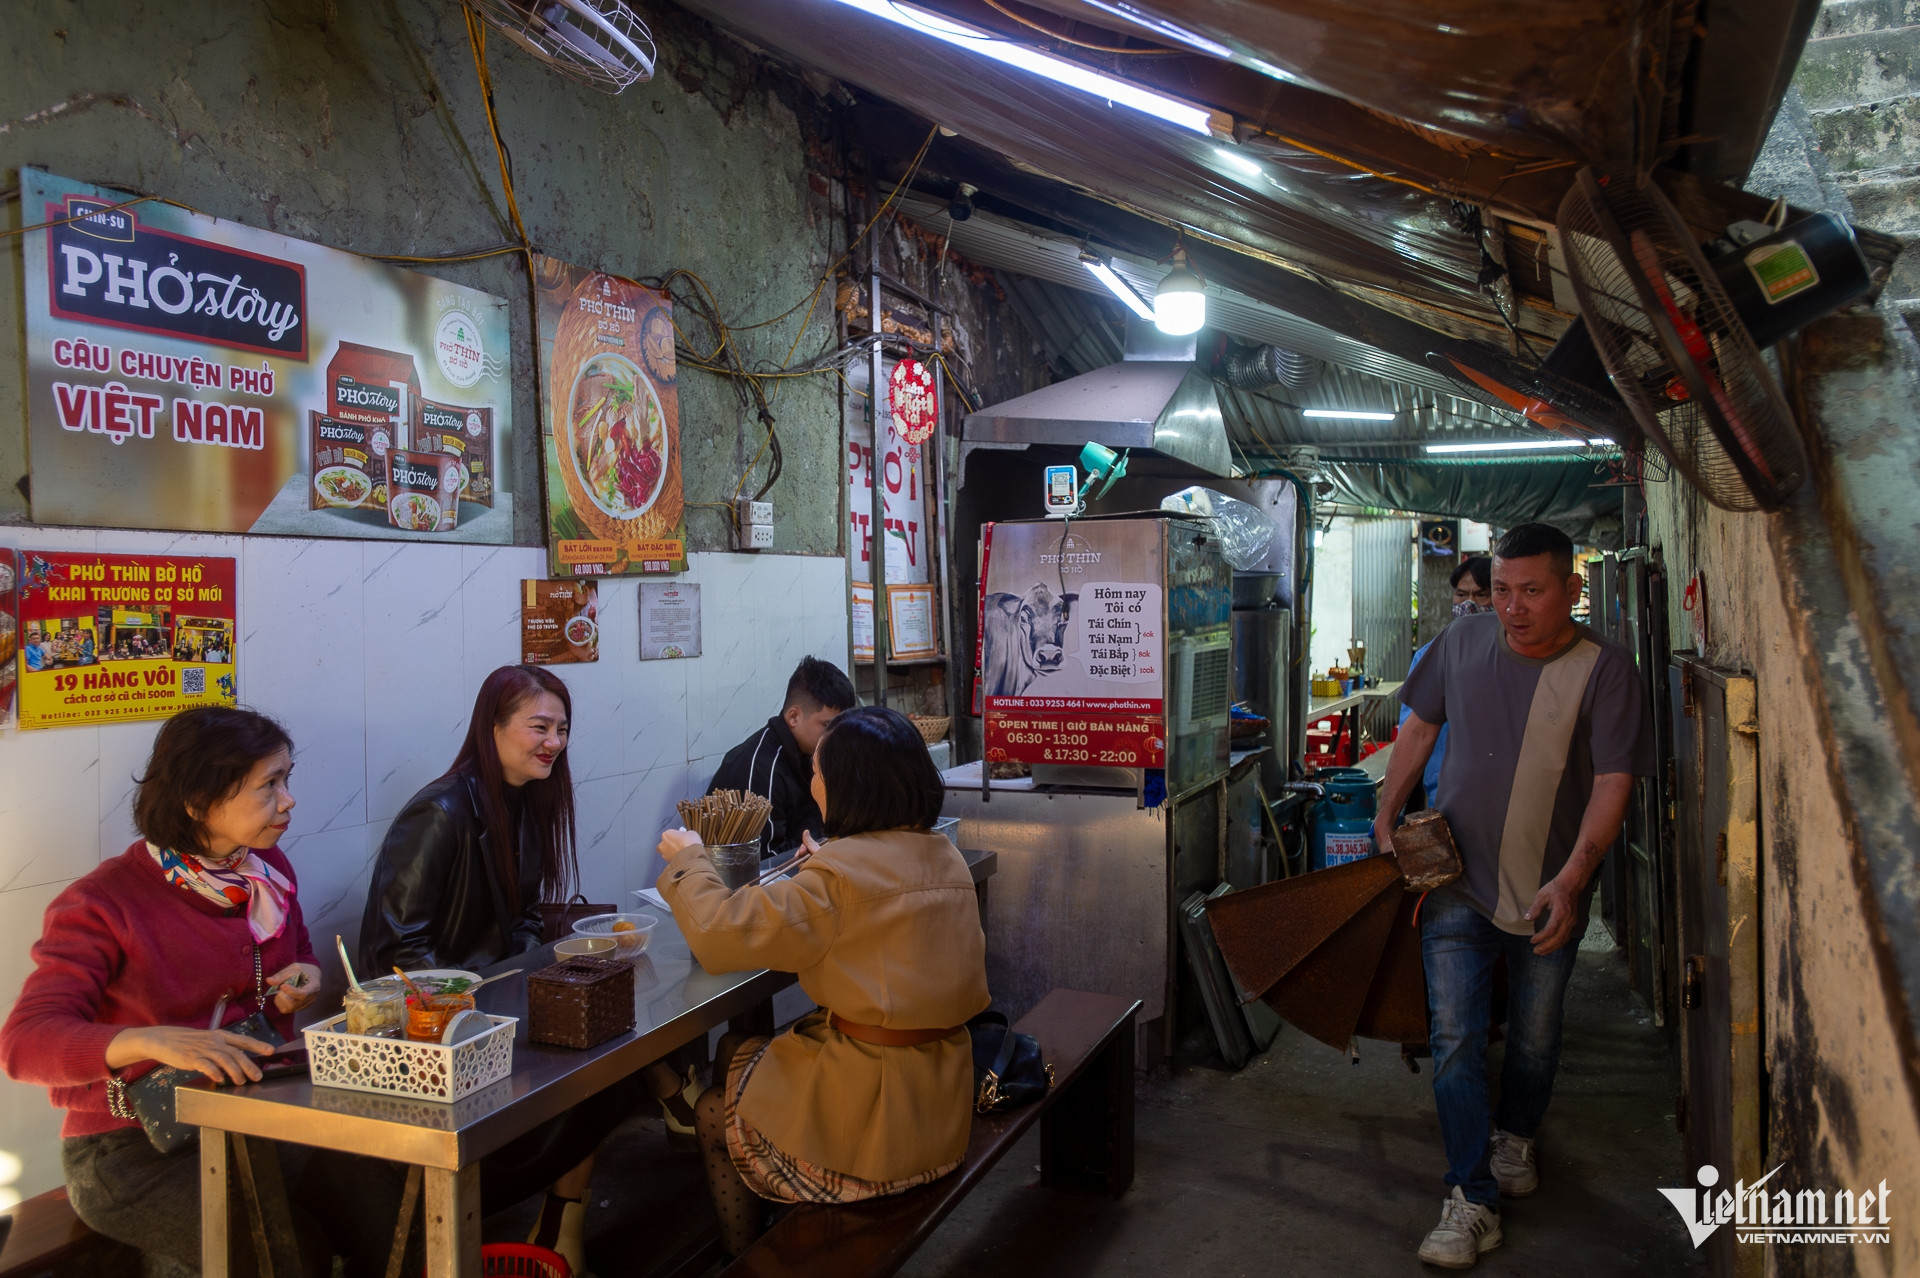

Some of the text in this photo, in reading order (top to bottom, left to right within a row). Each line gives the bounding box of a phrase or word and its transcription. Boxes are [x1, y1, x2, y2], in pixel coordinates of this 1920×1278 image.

[77, 206, 125, 230] CHIN-SU
[579, 293, 636, 323] PHỞ THÌN
[598, 317, 620, 333] BỜ HỒ
[454, 342, 481, 363] THÌN
[53, 337, 275, 396] CÂU CHUYỆN PHỞ
[56, 385, 262, 447] VIỆT NAM
[563, 541, 577, 553] BÁT
[637, 541, 649, 552] BÁT
[1066, 548, 1102, 564] THÌN
[69, 557, 205, 583] PHỞ THÌN BỜ HỒ
[574, 563, 592, 575] 60.000
[48, 582, 222, 602] KHAI TRƯƠNG CƠ SỞ MỚI
[1094, 587, 1147, 602] Hôm nay
[1104, 601, 1142, 613] Tôi có
[1088, 617, 1132, 629] Tái Chín
[1088, 633, 1133, 647] Tái Nạm
[1142, 630, 1154, 638] 60k
[1091, 647, 1129, 662] Tái Bắp
[1138, 650, 1151, 658] 80k
[1089, 664, 1131, 678] Đặc Biệt
[1139, 666, 1155, 674] 100k
[54, 665, 176, 692] 19 HÀNG VÔI
[63, 688, 176, 705] cách cơ sở cũ chỉ 500m
[993, 698, 1025, 707] HOTLINE
[1029, 699, 1046, 707] 033
[1046, 699, 1066, 708] 9253
[1066, 700, 1081, 708] 464
[1086, 700, 1151, 710] www.phothin.vn
[41, 711, 81, 720] Hotline:
[84, 709, 101, 717] 033
[998, 720, 1029, 730] OPEN
[1031, 721, 1058, 730] TIME
[1066, 720, 1088, 732] GIỜ
[1090, 721, 1113, 732] BÁN
[1116, 721, 1149, 733] HÀNG
[1007, 732, 1043, 744] 06:30
[1053, 734, 1088, 746] 13:00
[1043, 748, 1053, 760] &
[1055, 749, 1089, 761] 17:30
[1100, 751, 1137, 763] 22:00
